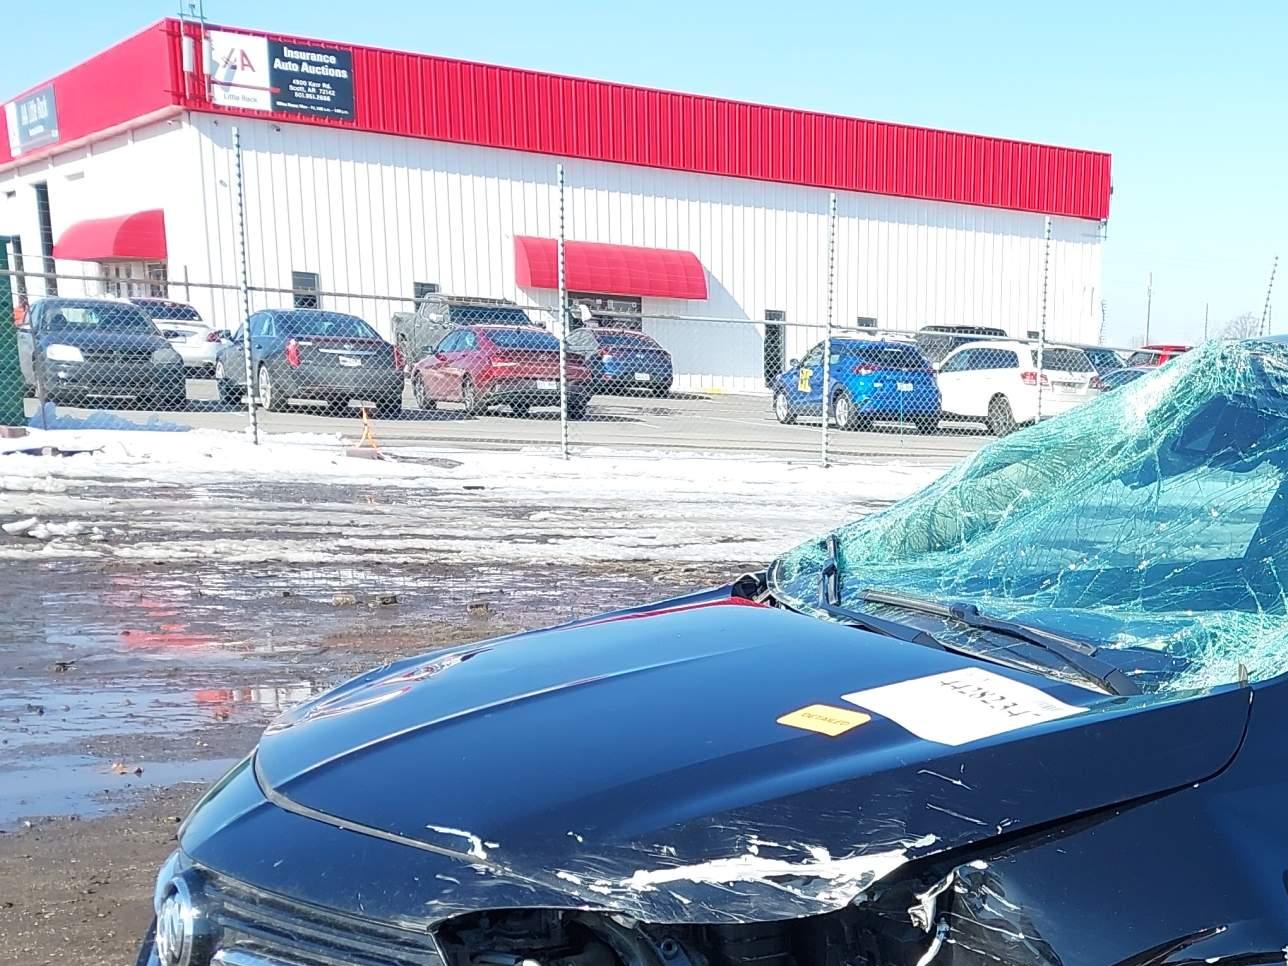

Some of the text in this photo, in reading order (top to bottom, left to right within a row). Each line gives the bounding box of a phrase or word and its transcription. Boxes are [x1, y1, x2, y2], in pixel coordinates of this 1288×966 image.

[283, 47, 336, 63] Insurance
[273, 58, 348, 79] Auto Auctions
